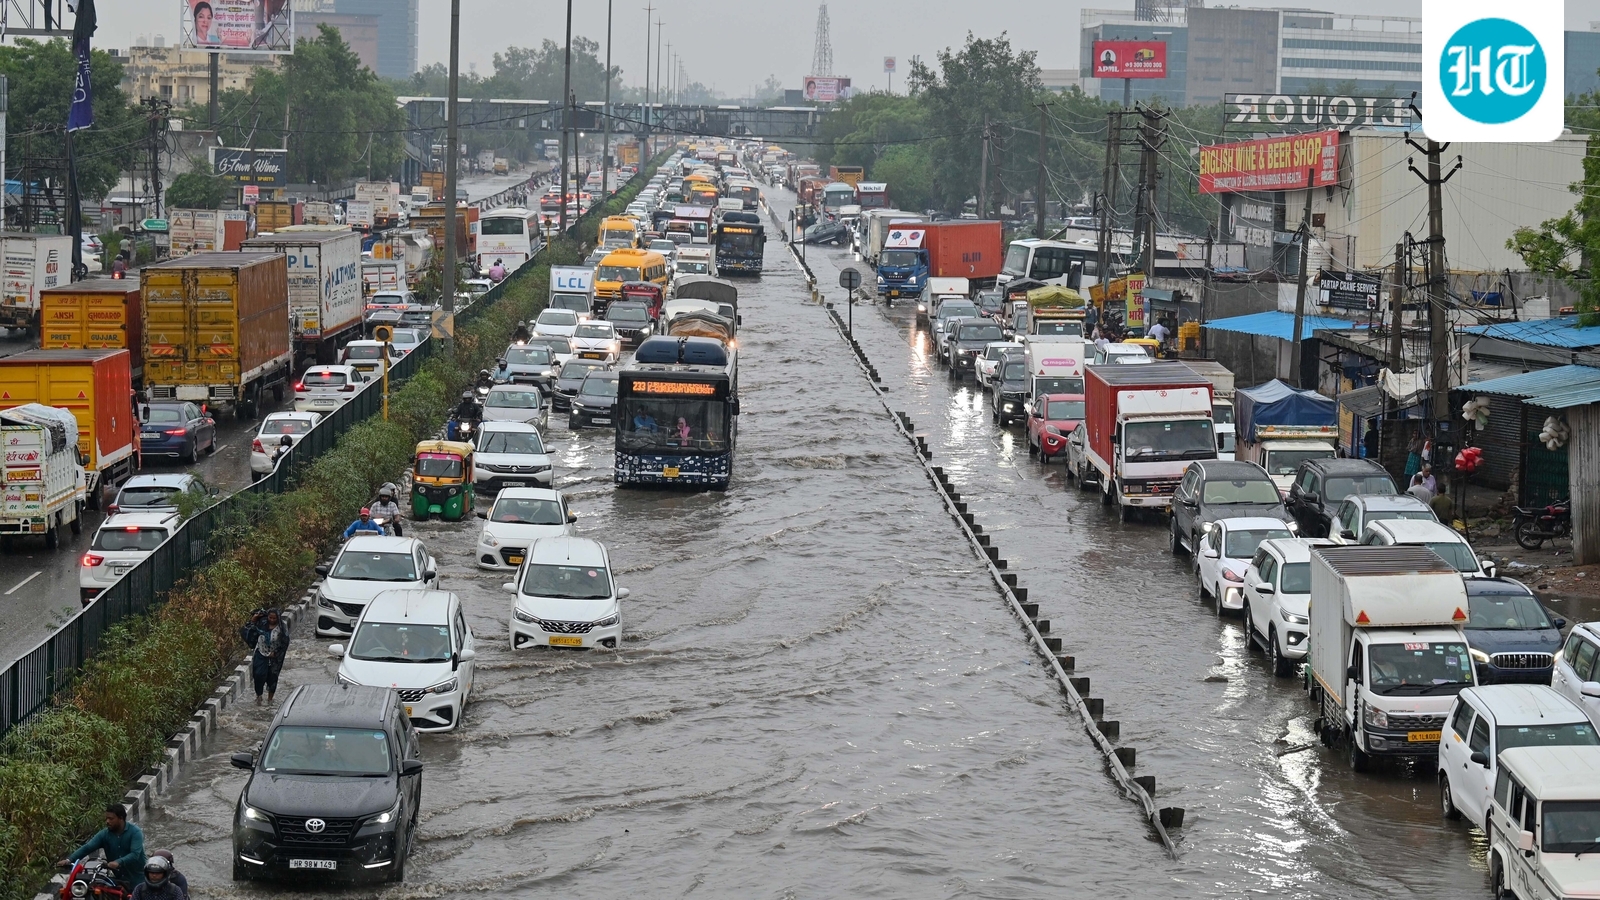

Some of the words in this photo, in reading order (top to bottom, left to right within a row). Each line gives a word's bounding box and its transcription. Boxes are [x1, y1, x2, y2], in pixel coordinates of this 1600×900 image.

[1200, 148, 1233, 175] ENGLISH
[1235, 145, 1257, 172] WINE
[1258, 144, 1265, 170] &
[1267, 141, 1291, 169] BEER
[1293, 138, 1322, 167] SHOP
[252, 159, 281, 173] Wines
[1237, 176, 1242, 187] OF
[1281, 173, 1286, 184] TO
[1287, 171, 1302, 183] HEALTH
[557, 277, 586, 289] LCL
[1320, 279, 1339, 290] PARTAP
[1339, 281, 1356, 292] CRANE
[1356, 282, 1377, 294] SERVICE
[53, 312, 74, 320] ANSH
[91, 334, 120, 342] GUJJAR
[1049, 359, 1076, 367] magenta
[632, 381, 646, 391] 233
[320, 861, 336, 869] 1491
